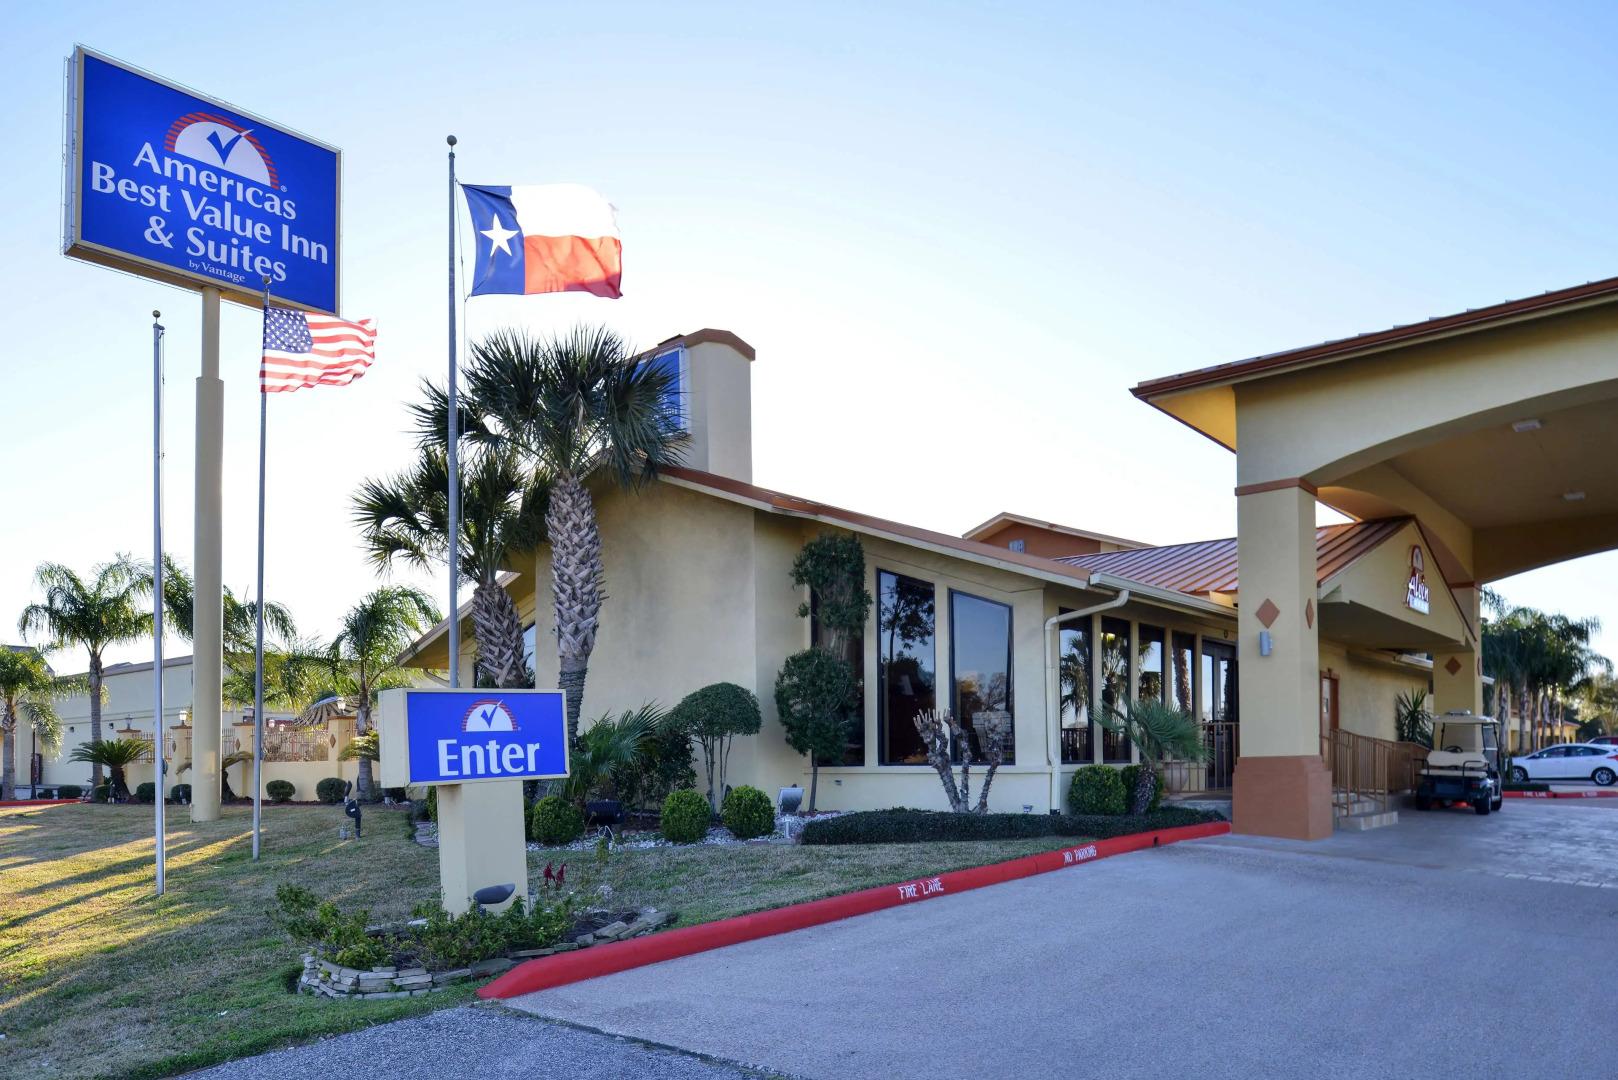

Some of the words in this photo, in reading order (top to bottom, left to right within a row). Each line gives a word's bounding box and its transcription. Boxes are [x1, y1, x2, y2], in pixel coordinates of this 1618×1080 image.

[133, 141, 296, 220] Americas
[91, 160, 171, 212] Best
[180, 189, 271, 244] Value
[281, 223, 328, 265] Inn
[143, 215, 174, 249] &
[186, 227, 286, 281] Suites
[189, 259, 200, 271] by
[201, 262, 246, 283] Vantage
[437, 739, 540, 777] Enter
[897, 883, 919, 900] FIRE
[920, 877, 945, 895] LANE
